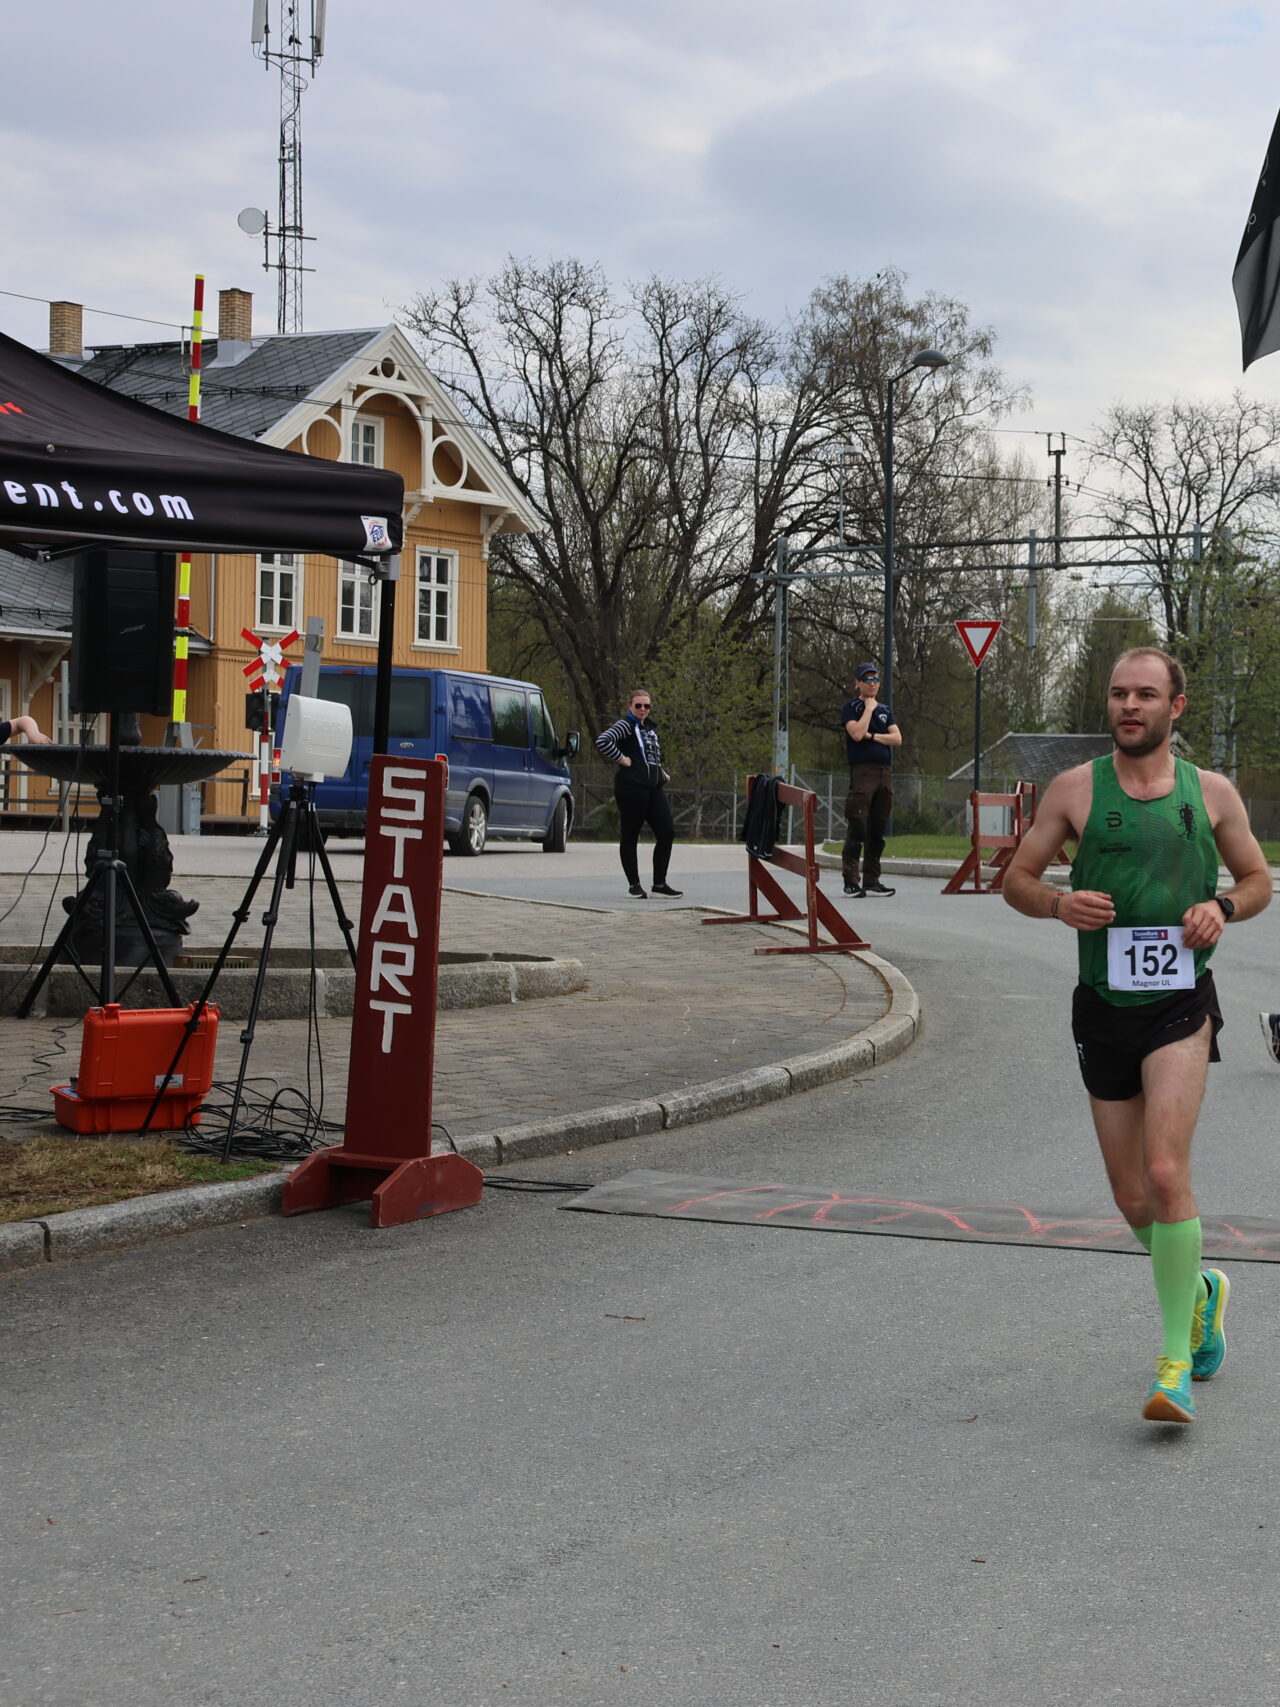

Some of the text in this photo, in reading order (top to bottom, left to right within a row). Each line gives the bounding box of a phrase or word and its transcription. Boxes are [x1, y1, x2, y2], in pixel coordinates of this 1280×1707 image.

[3, 480, 194, 520] ent.com
[369, 766, 427, 1053] START
[1124, 944, 1178, 976] 152
[1132, 980, 1160, 988] Magnor
